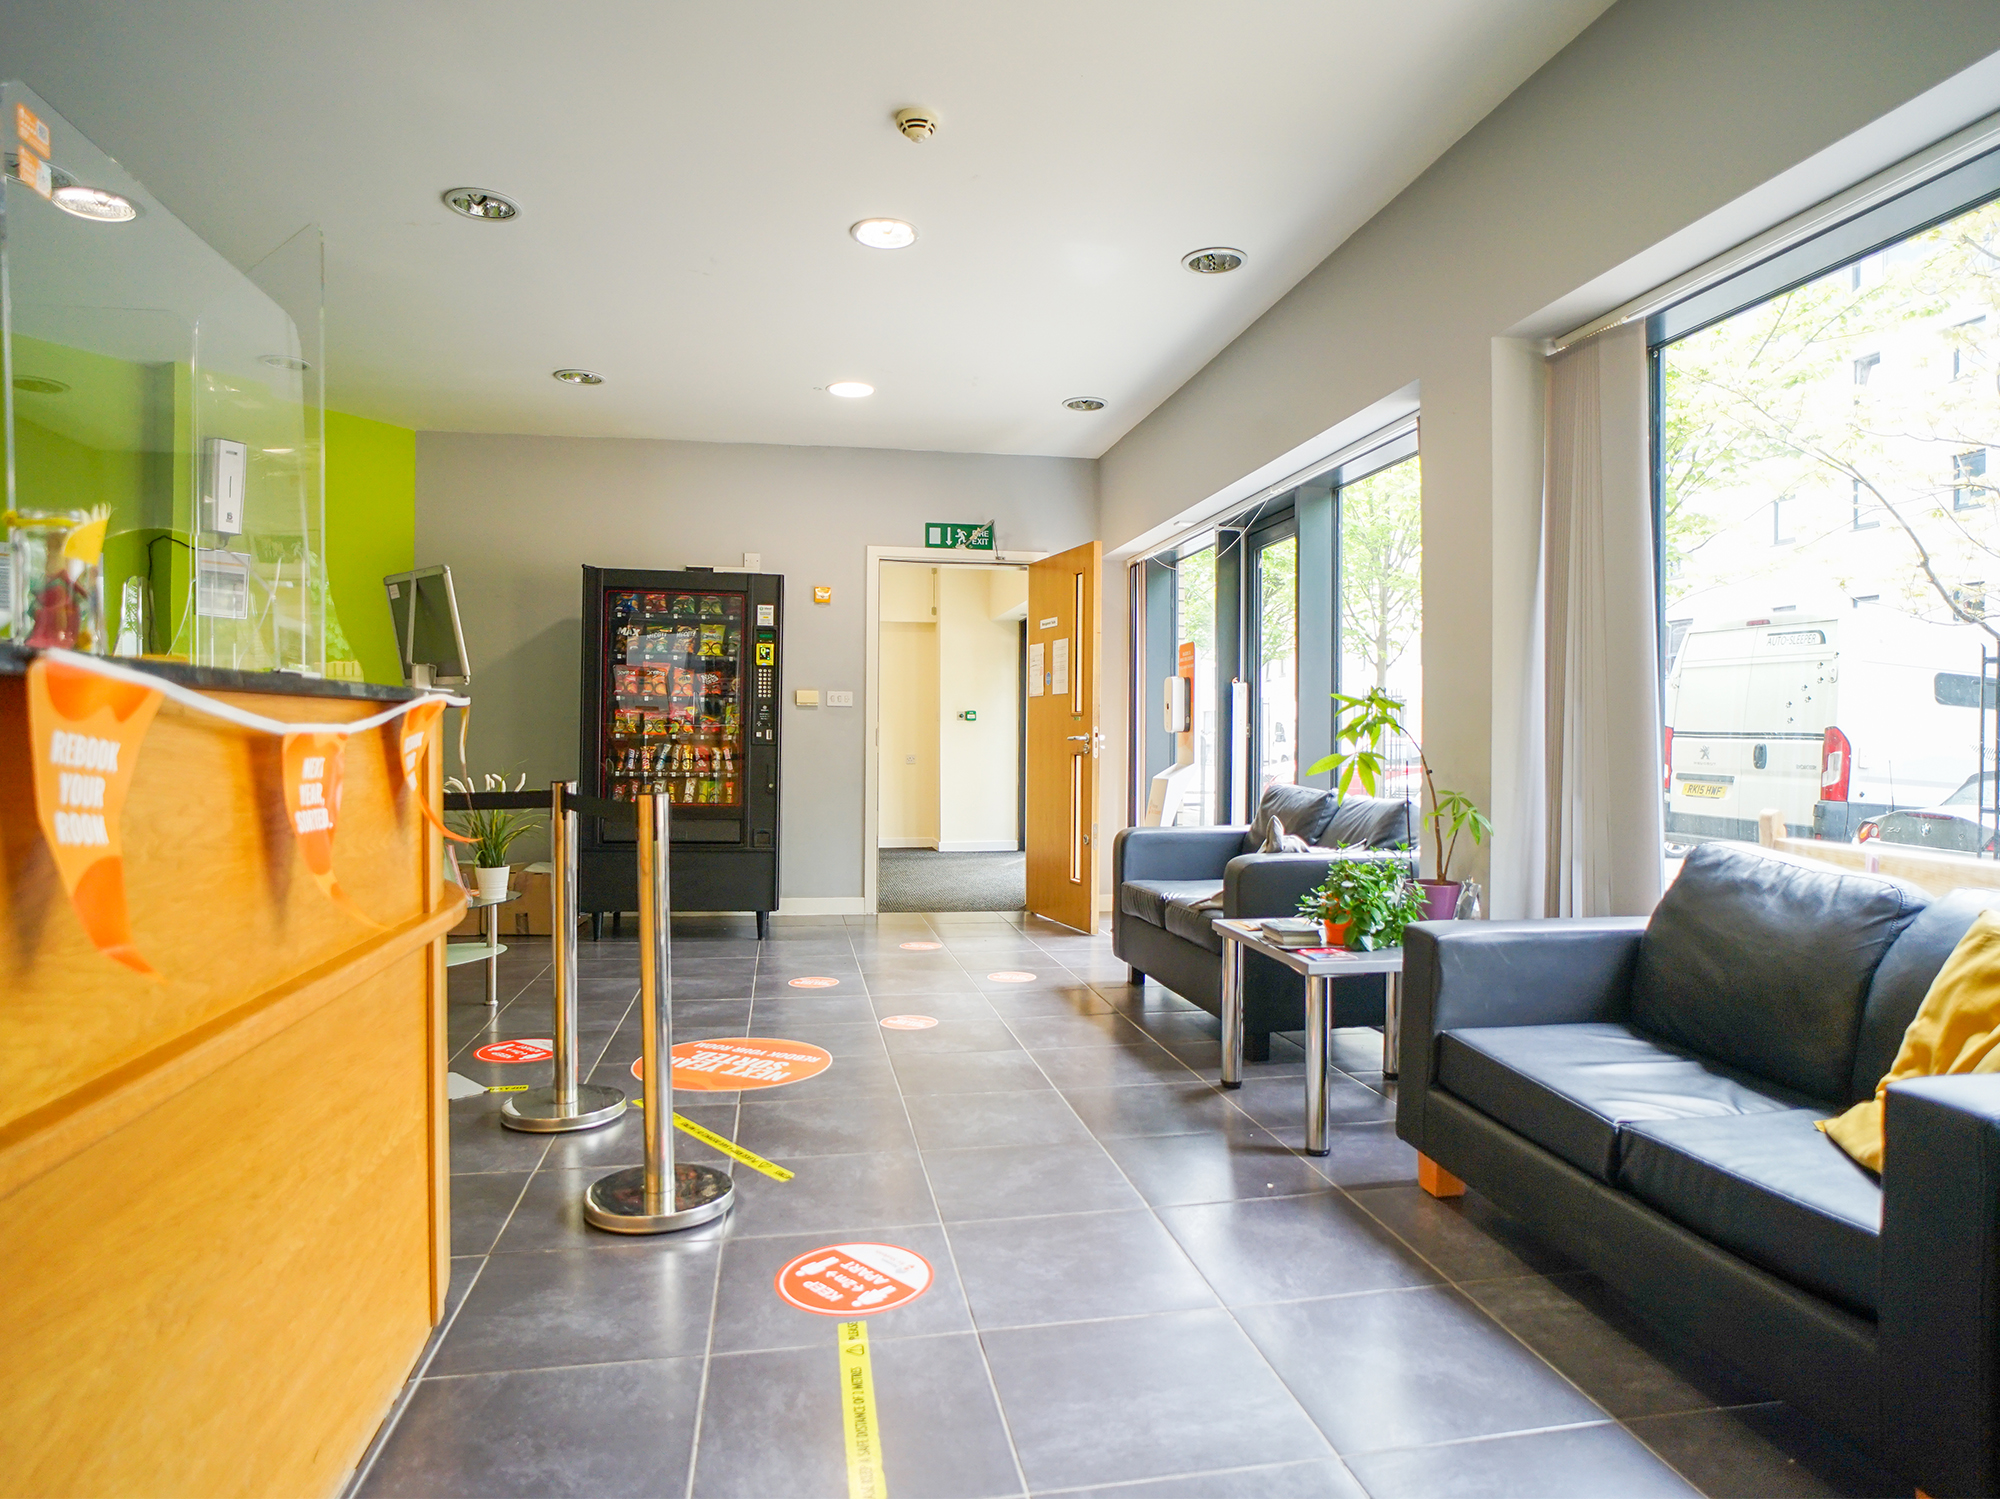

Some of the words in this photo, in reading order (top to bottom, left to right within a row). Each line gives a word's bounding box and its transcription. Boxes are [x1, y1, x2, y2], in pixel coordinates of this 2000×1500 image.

[971, 538, 990, 546] EXIT
[617, 626, 641, 637] MAX
[50, 729, 122, 774] REBOOK
[302, 756, 326, 780] NEXT
[59, 772, 106, 810] YOUR
[1686, 784, 1705, 794] RK15
[1705, 786, 1723, 796] HWF
[54, 810, 110, 847] ROOM
[294, 807, 334, 834] SORTED.
[694, 1041, 731, 1051] ROOM
[732, 1046, 764, 1056] YOUR
[693, 1050, 789, 1070] SORTED.
[767, 1050, 821, 1063] REBOOK
[720, 1066, 791, 1082] NEXT
[839, 1261, 890, 1285] APART
[802, 1281, 844, 1302] KEEP
